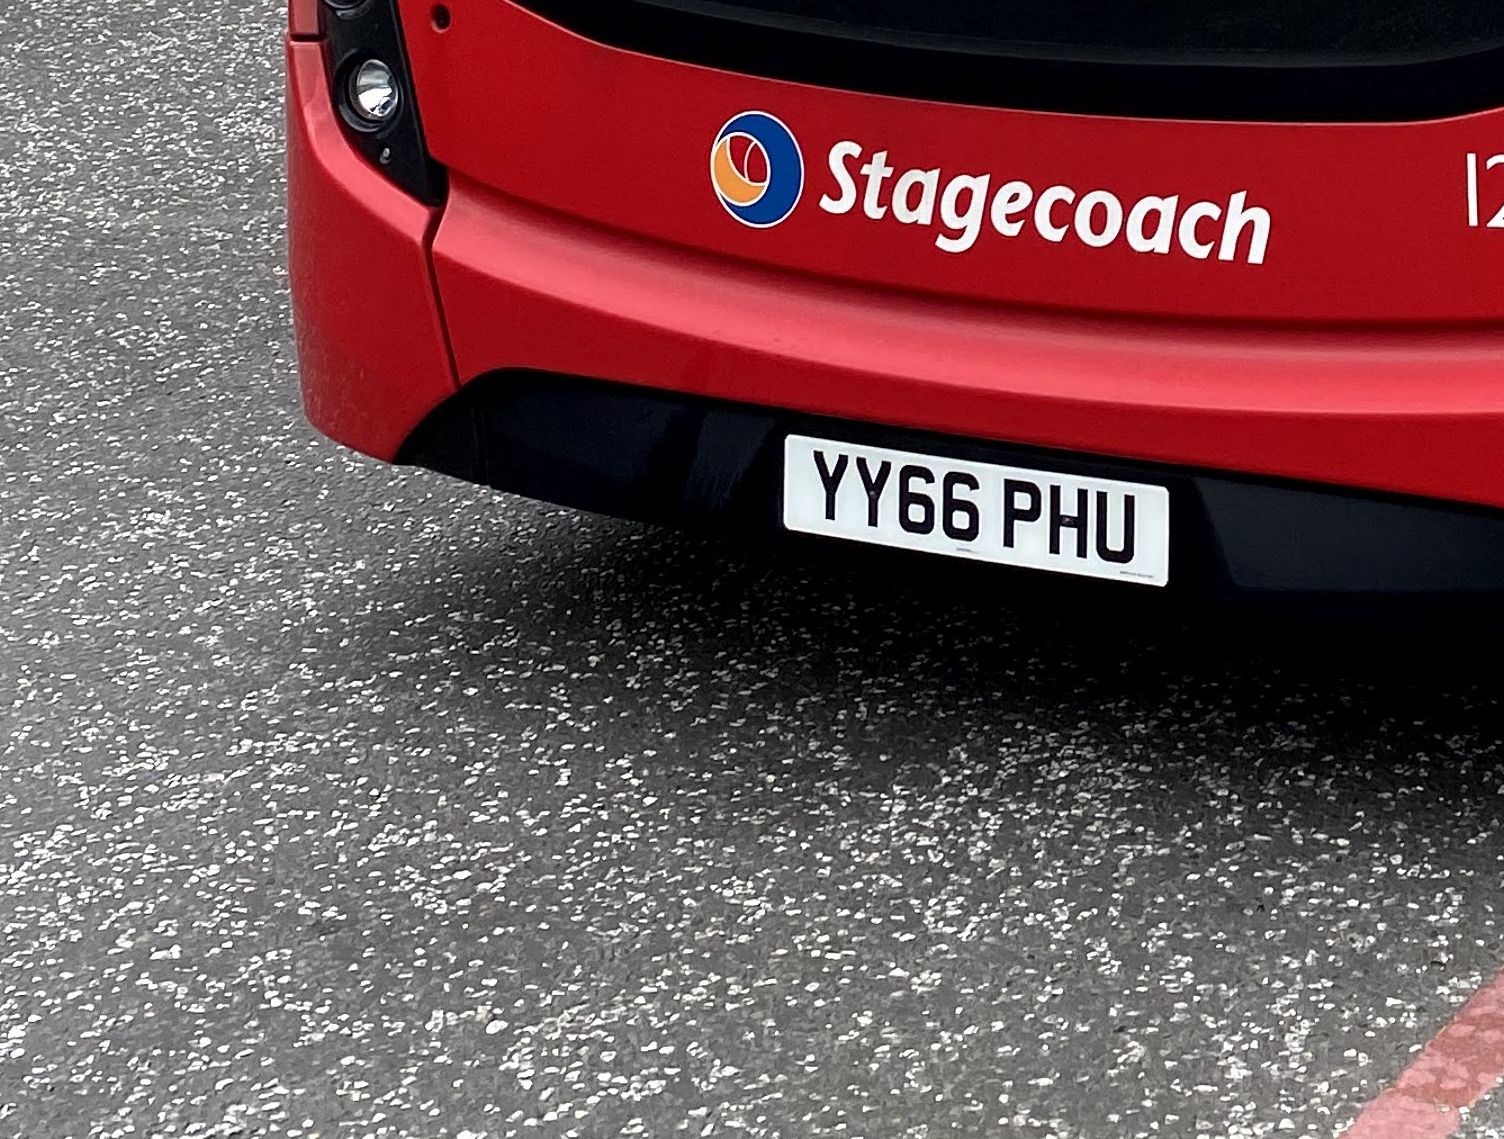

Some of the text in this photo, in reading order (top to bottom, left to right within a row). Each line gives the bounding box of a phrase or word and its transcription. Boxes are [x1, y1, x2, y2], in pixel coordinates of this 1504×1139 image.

[819, 140, 1271, 265] Stagecoach
[813, 449, 1136, 564] YY66 PHU
